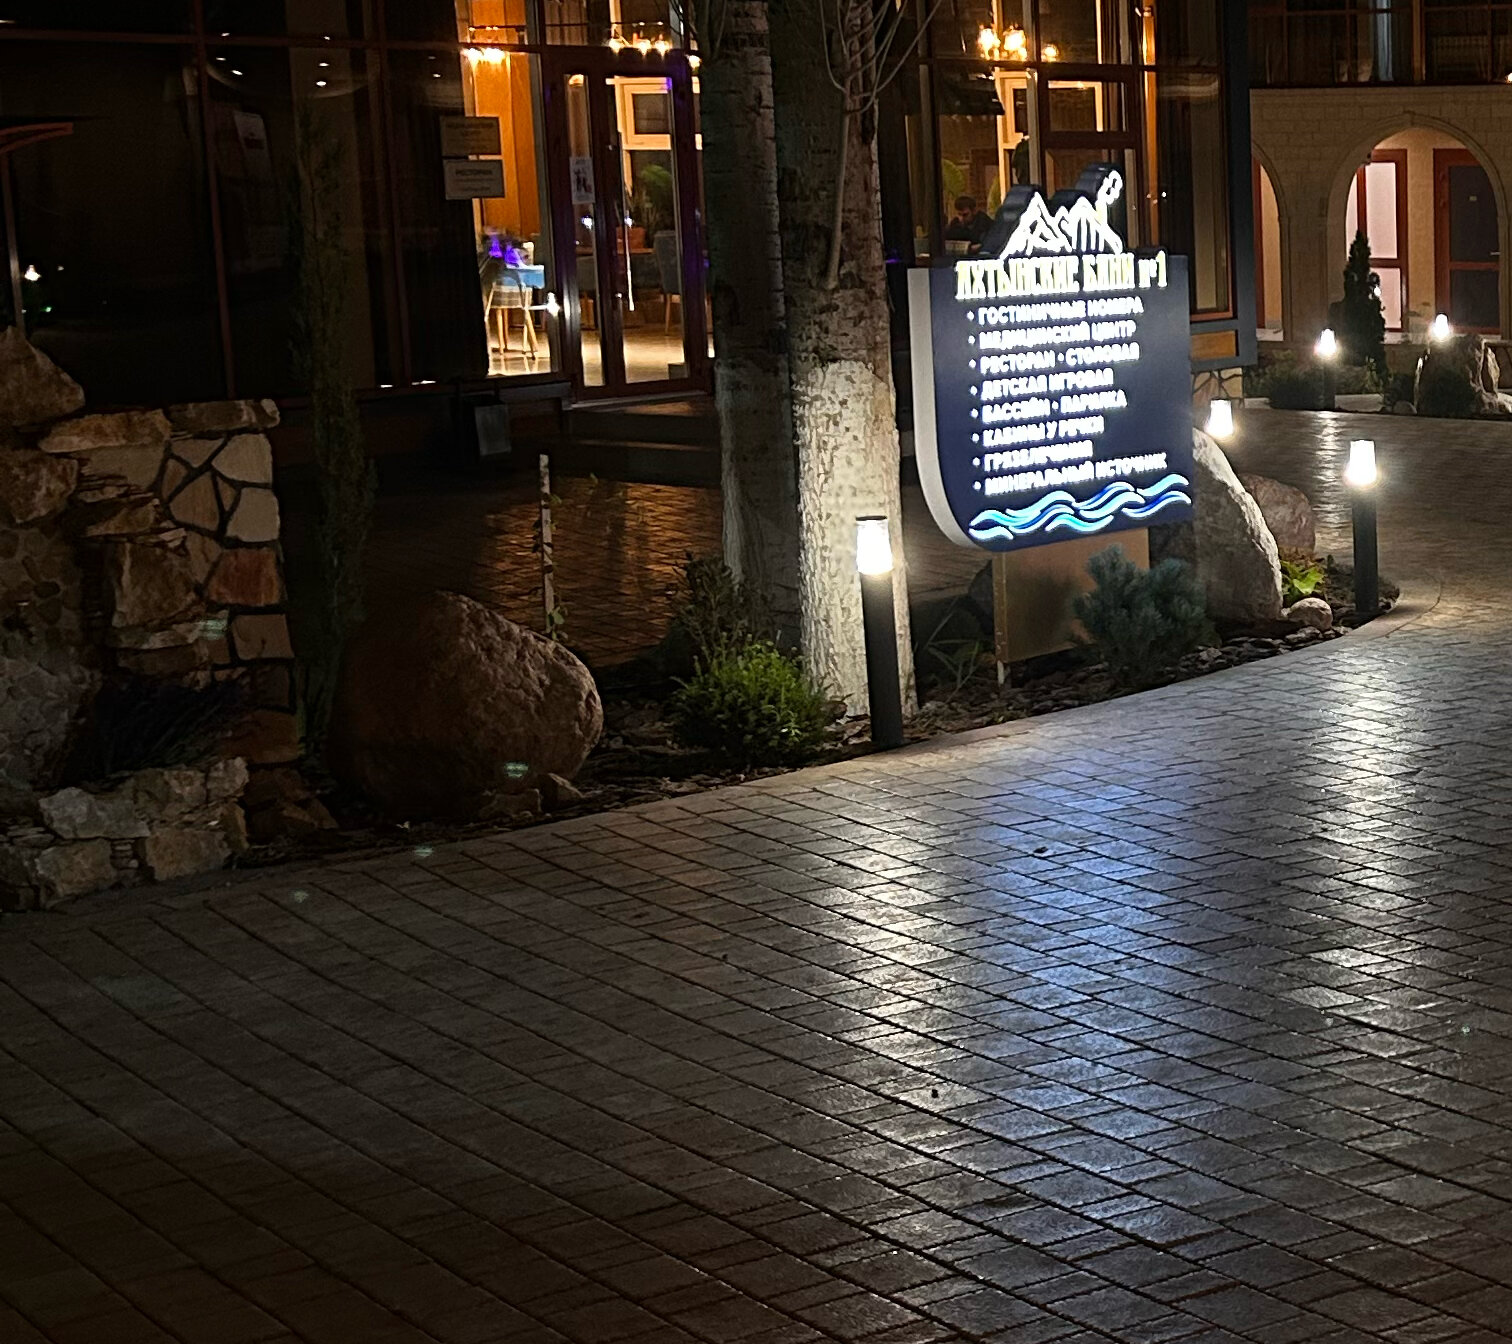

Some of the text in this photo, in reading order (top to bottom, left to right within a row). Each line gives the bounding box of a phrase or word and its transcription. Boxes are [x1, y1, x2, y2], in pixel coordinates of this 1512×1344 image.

[1081, 252, 1135, 292] БАНИ
[977, 296, 1144, 326] ГОСТИНИЧНЫЕ НОМЕРА
[979, 320, 1137, 350] МЕДИЦИНСКИЙ ЦЕНТР
[980, 342, 1140, 375] РЕСТОРАН СТОЛОВАЯ
[981, 367, 1114, 401] ДЕТСКАЯ ИГРОВАЯ
[1046, 421, 1058, 439] У
[984, 452, 1167, 495] МИНЕРАЛЬНЫЙ ИСТОЧНИК
